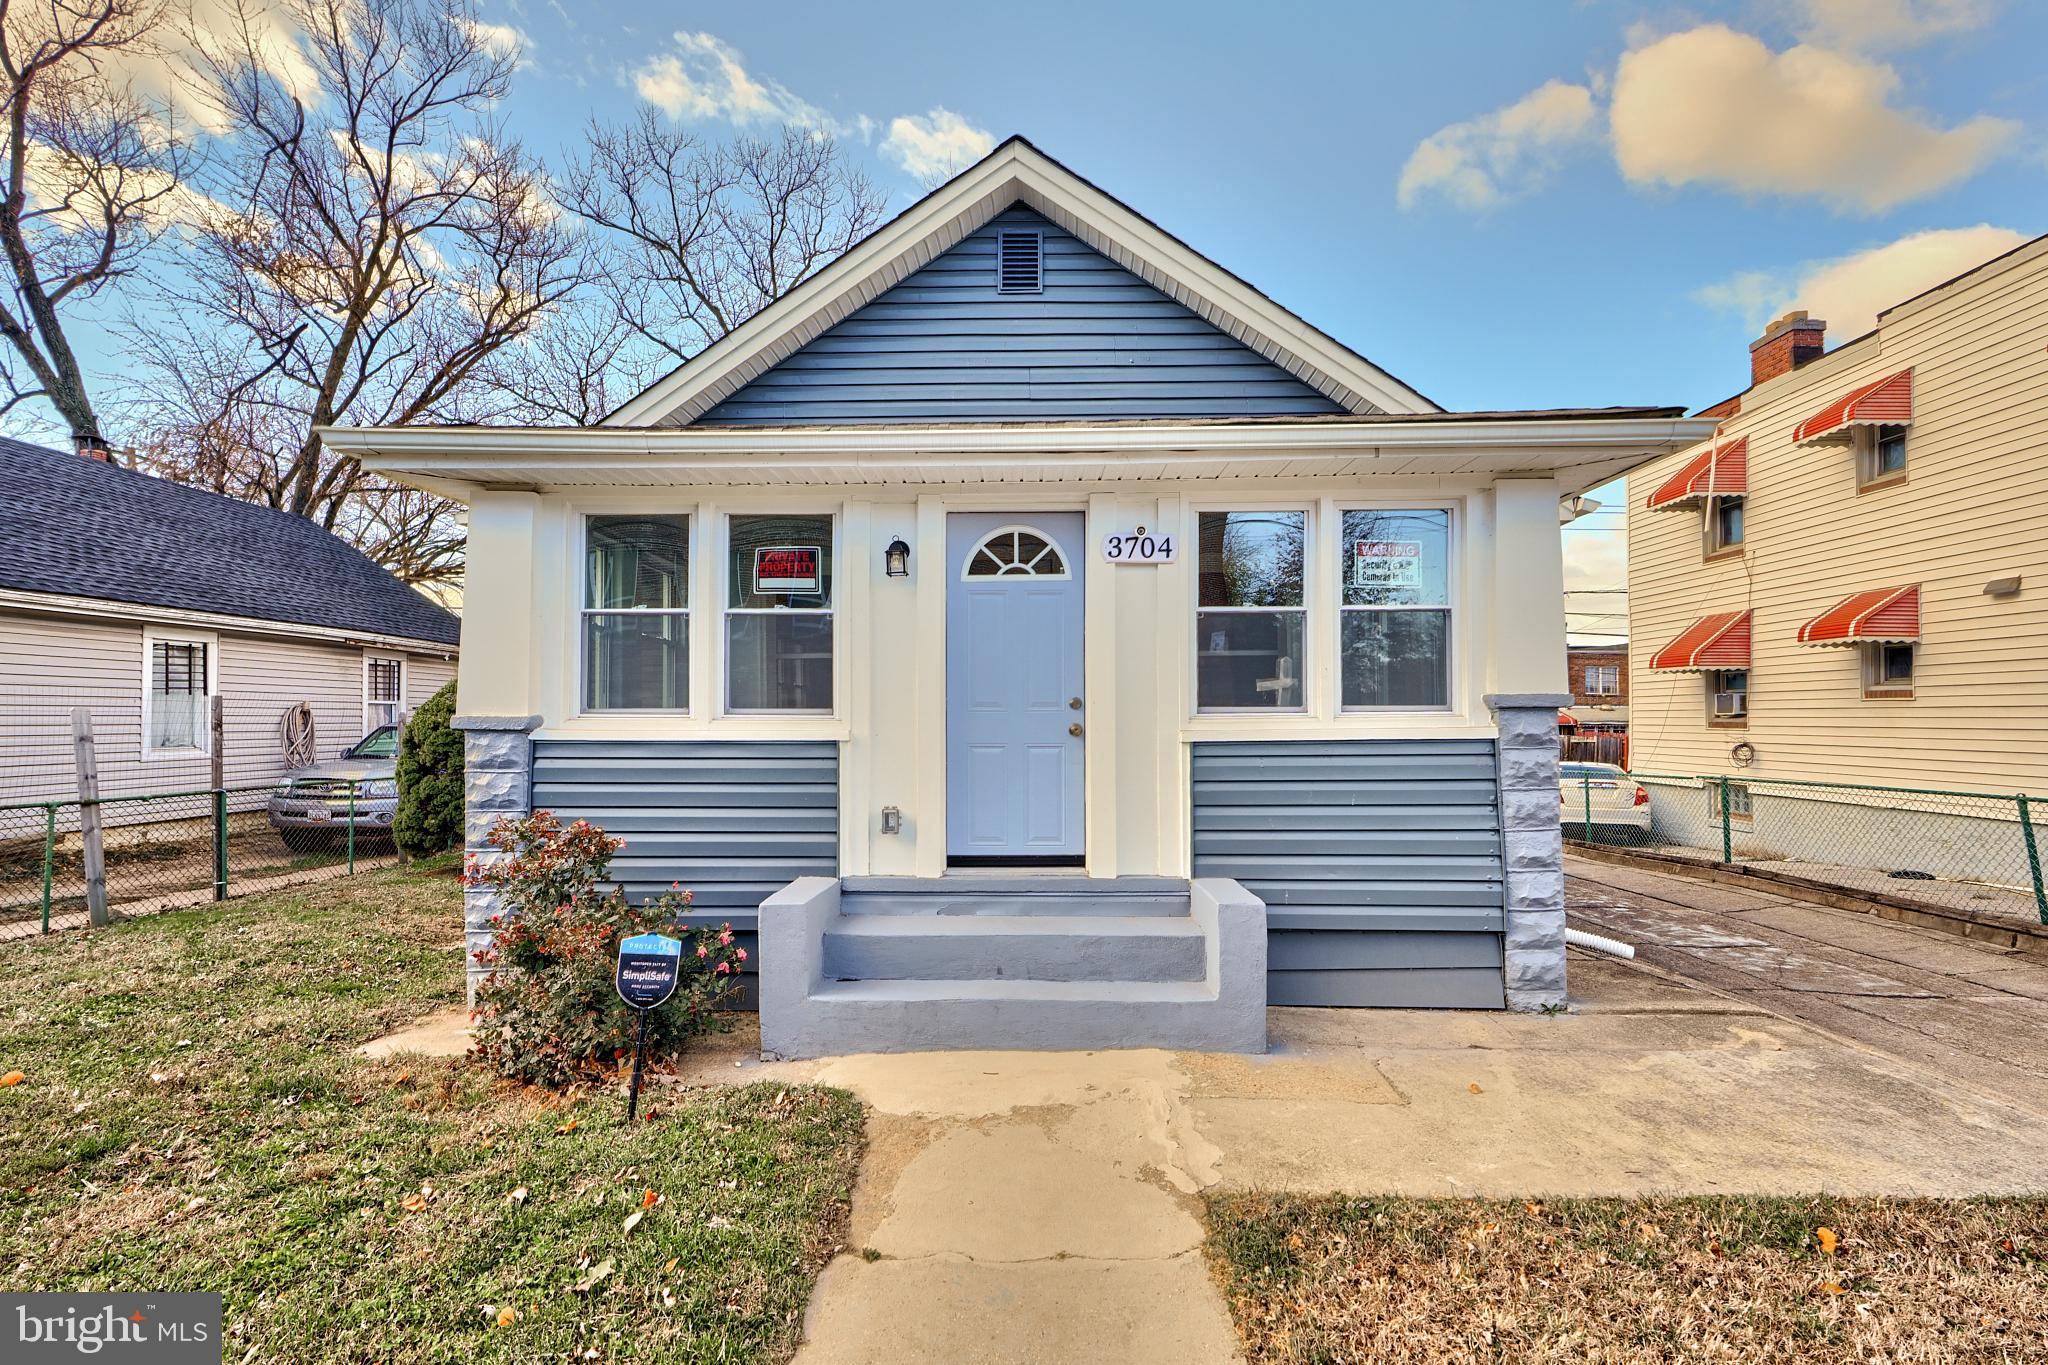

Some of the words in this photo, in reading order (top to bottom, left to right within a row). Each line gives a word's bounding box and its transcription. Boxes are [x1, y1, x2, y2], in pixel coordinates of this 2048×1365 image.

[1108, 536, 1173, 559] 3704
[1361, 544, 1415, 556] WARNING
[764, 551, 810, 562] PRIVATE
[759, 562, 815, 573] PROPERTY
[1361, 559, 1391, 571] Security
[1362, 571, 1391, 581] Cameras
[622, 970, 671, 982] SimpliSafe
